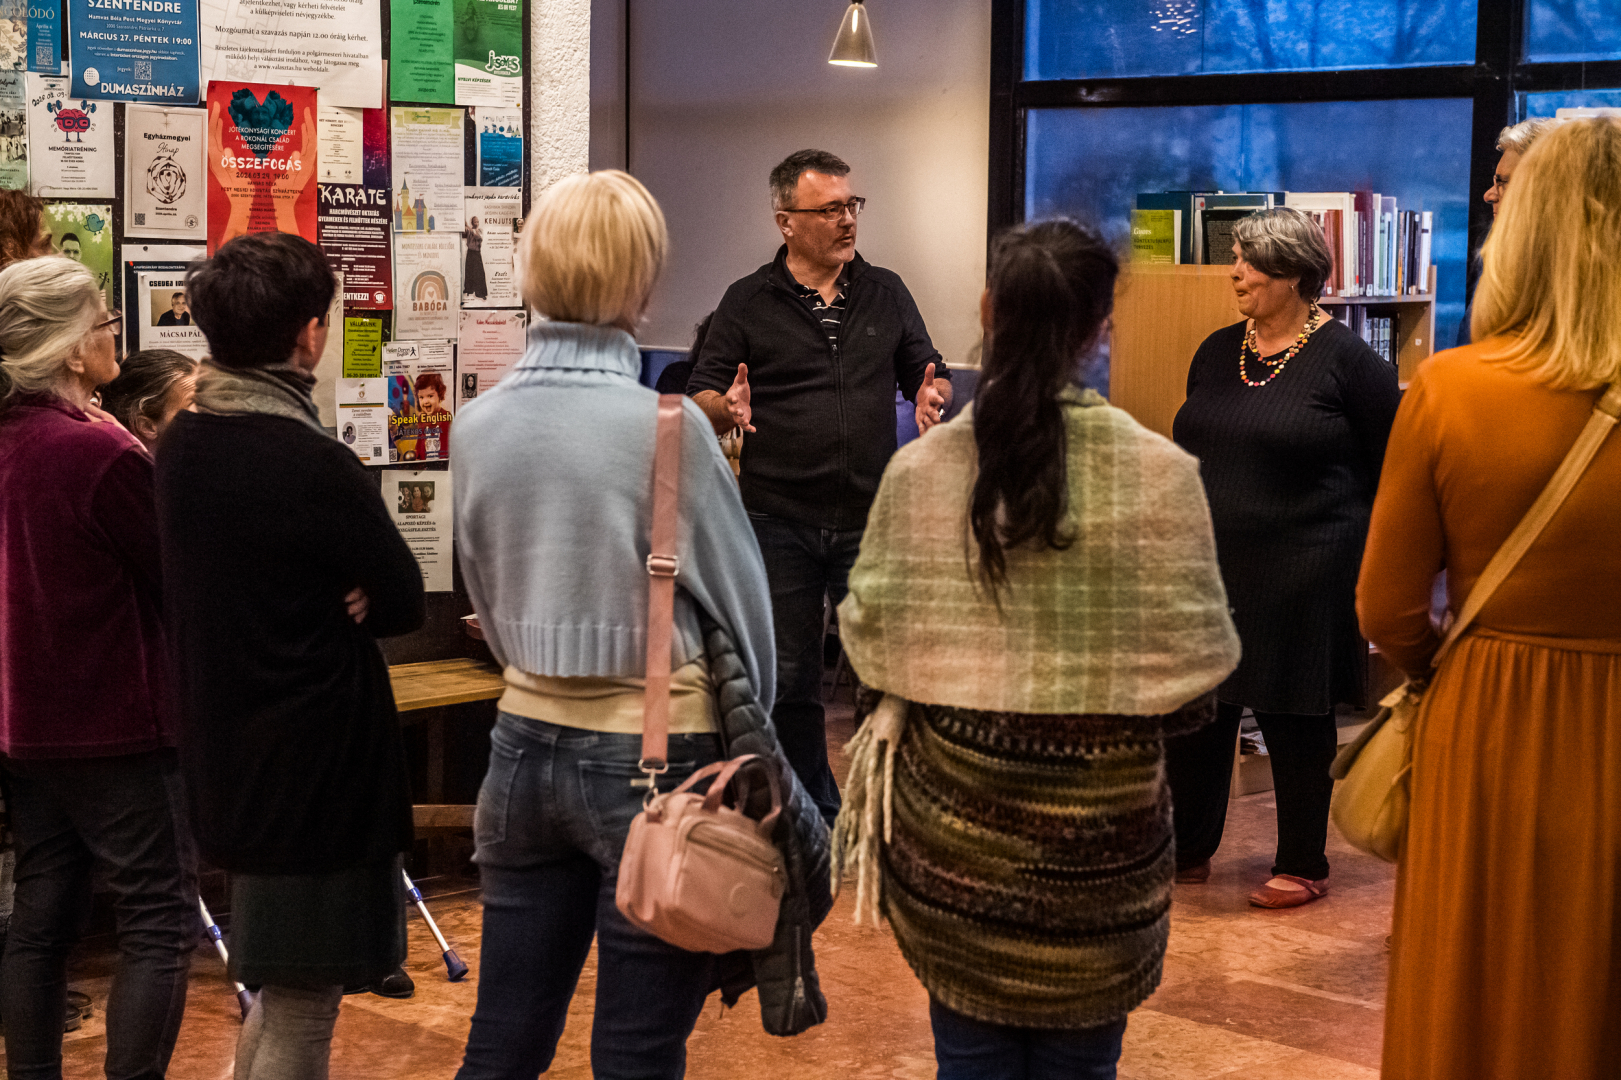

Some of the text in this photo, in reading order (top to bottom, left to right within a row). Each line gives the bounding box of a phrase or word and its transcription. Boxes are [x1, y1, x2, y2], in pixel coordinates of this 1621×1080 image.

[88, 0, 181, 13] SZENTENDRE
[80, 30, 118, 40] MÁRCIUS
[134, 34, 169, 44] PÉNTEK
[289, 31, 310, 39] napján
[330, 32, 346, 42] óráig
[348, 33, 368, 41] kérhet.
[100, 82, 184, 97] DUMASZÍNHÁZ
[144, 132, 190, 142] Egyházmegyei
[228, 126, 296, 136] JÓTÉKONYSÁGI KONCERT
[268, 136, 290, 144] CSALÁD
[221, 155, 302, 172] ÖSSZEFOGÁS
[321, 185, 386, 206] KARATE
[344, 292, 370, 300] ENTKEZZ!
[412, 300, 448, 312] BABÓCA
[160, 330, 202, 338] MÁCSAI PÁL
[392, 412, 452, 426] Speak English
